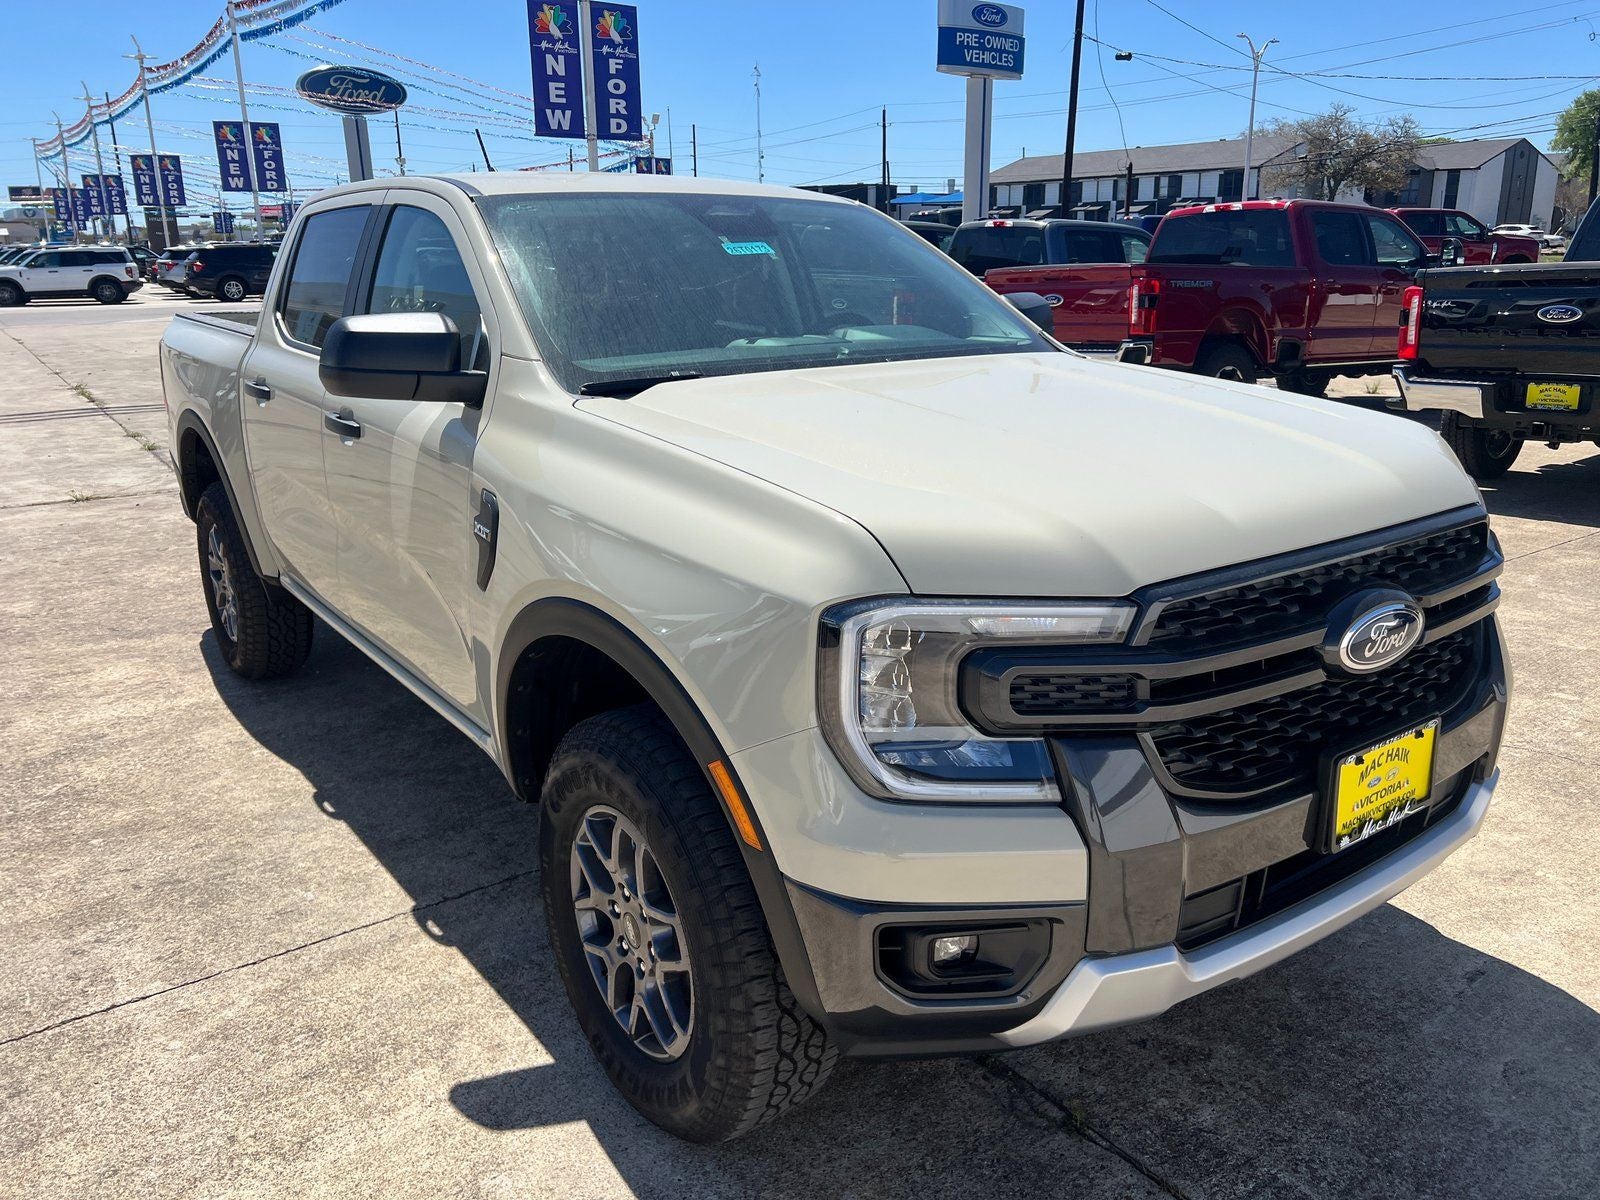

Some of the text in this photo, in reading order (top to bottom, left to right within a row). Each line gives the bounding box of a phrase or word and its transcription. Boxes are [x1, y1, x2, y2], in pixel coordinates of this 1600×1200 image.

[981, 7, 1001, 23] Ford
[956, 32, 1020, 52] PRE-OWNED
[964, 49, 1014, 67] VEHICLES
[325, 75, 386, 102] Ford
[545, 54, 572, 131] NEW
[607, 58, 628, 134] FORD
[226, 149, 244, 189] NEW
[264, 150, 278, 190] FORD
[88, 190, 101, 213] NEW
[111, 190, 121, 214] FORD
[140, 174, 154, 204] NEW
[168, 175, 180, 205] FORD
[1169, 280, 1214, 288] TREMOR
[1547, 308, 1571, 318] Ford
[1364, 618, 1409, 658] Ford
[1358, 750, 1384, 786] MAC
[1385, 747, 1411, 764] HAIK
[1341, 788, 1416, 830] MACHAIKVICTORIA.COM
[1359, 781, 1402, 809] VICTORIA
[1358, 801, 1423, 841] Mac Haik
